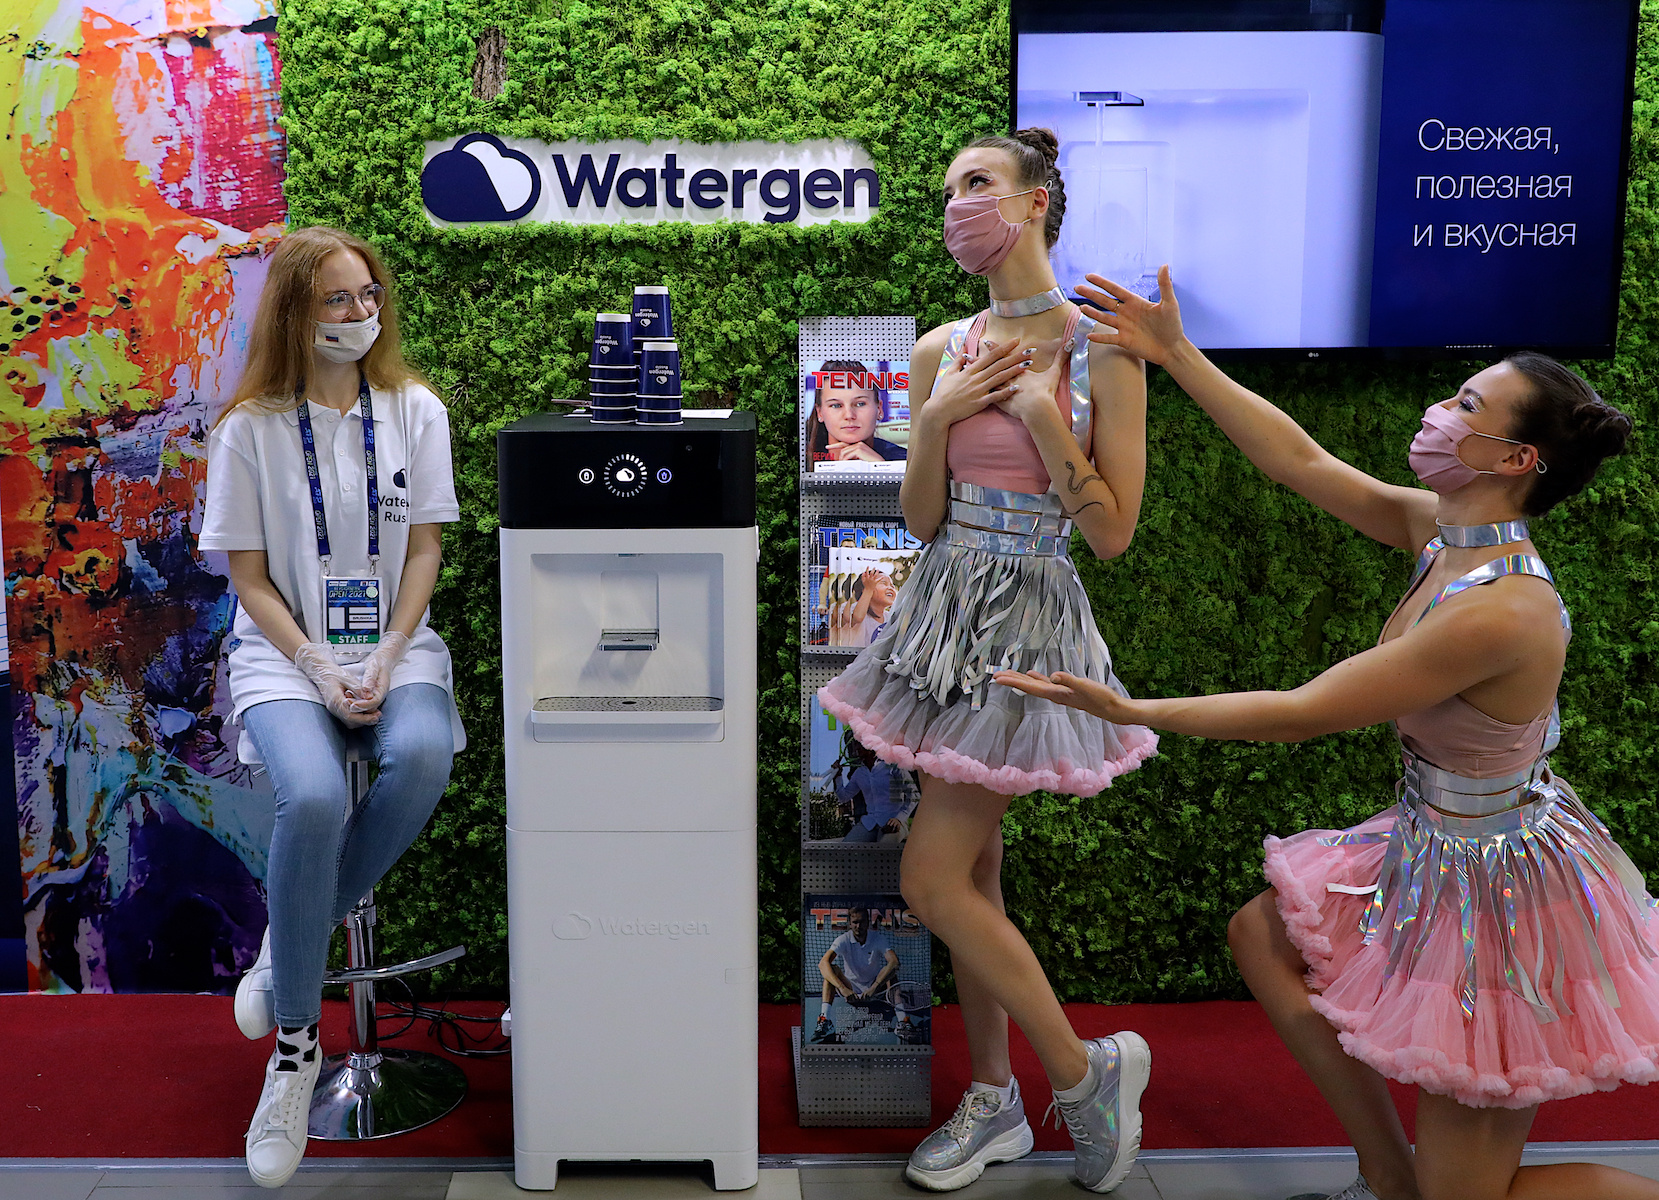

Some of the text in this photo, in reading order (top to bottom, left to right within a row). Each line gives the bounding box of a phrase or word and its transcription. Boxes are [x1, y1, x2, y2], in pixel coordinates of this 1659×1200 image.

[1417, 118, 1560, 154] Свежая,
[551, 153, 880, 223] Watergen
[1415, 172, 1572, 199] полезная
[1413, 222, 1577, 254] и вкусная
[811, 371, 909, 390] TENNIS
[348, 590, 366, 598] 2021
[338, 635, 369, 644] STAFF
[598, 917, 712, 941] Watergen
[810, 908, 920, 931] TENIS
